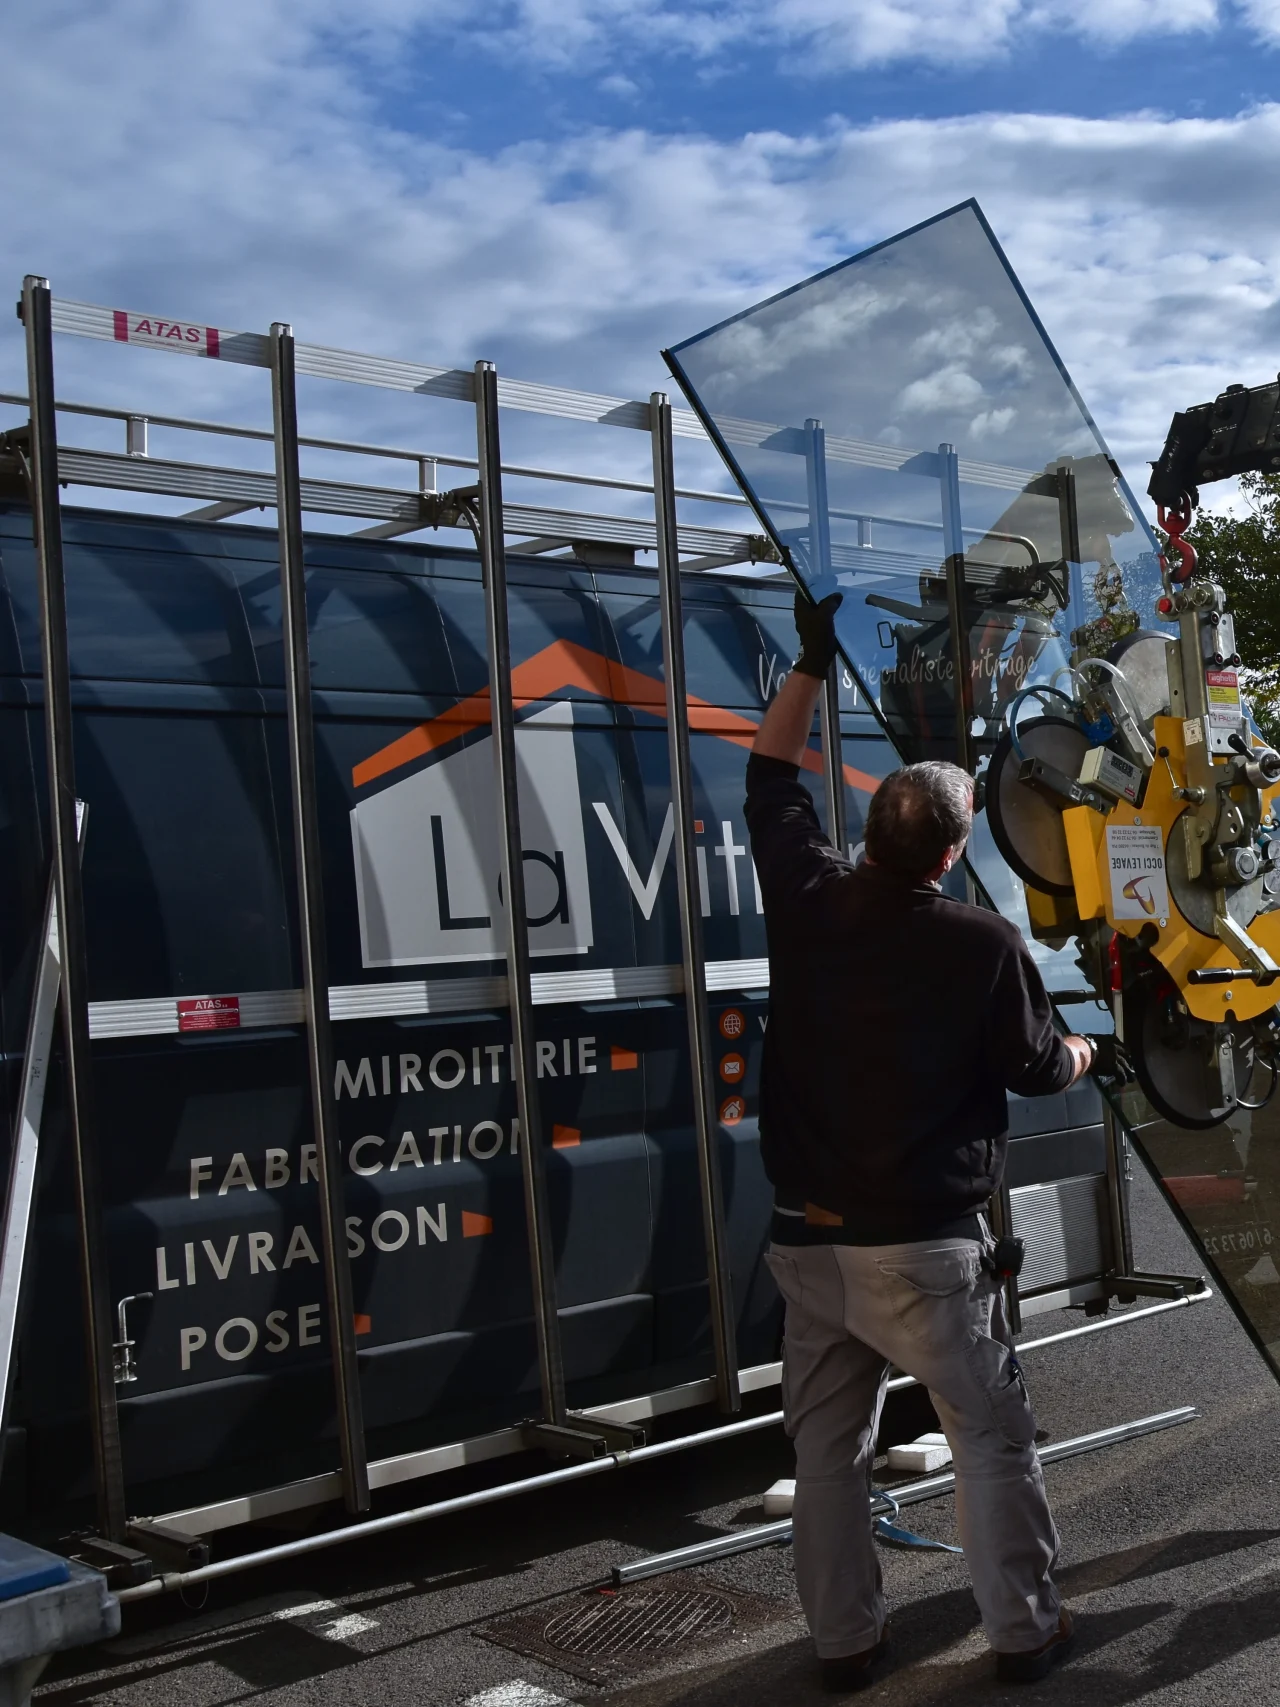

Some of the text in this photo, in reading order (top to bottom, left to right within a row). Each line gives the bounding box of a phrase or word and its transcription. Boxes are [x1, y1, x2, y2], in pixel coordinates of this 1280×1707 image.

[134, 319, 201, 343] ATAS
[592, 801, 766, 921] Vit
[1111, 857, 1163, 869] OCCI LEVAGE
[194, 999, 222, 1010] ATAS
[189, 1118, 519, 1200] FABRCATIO
[155, 1202, 448, 1291] LIVRASON
[179, 1303, 321, 1371] POSE
